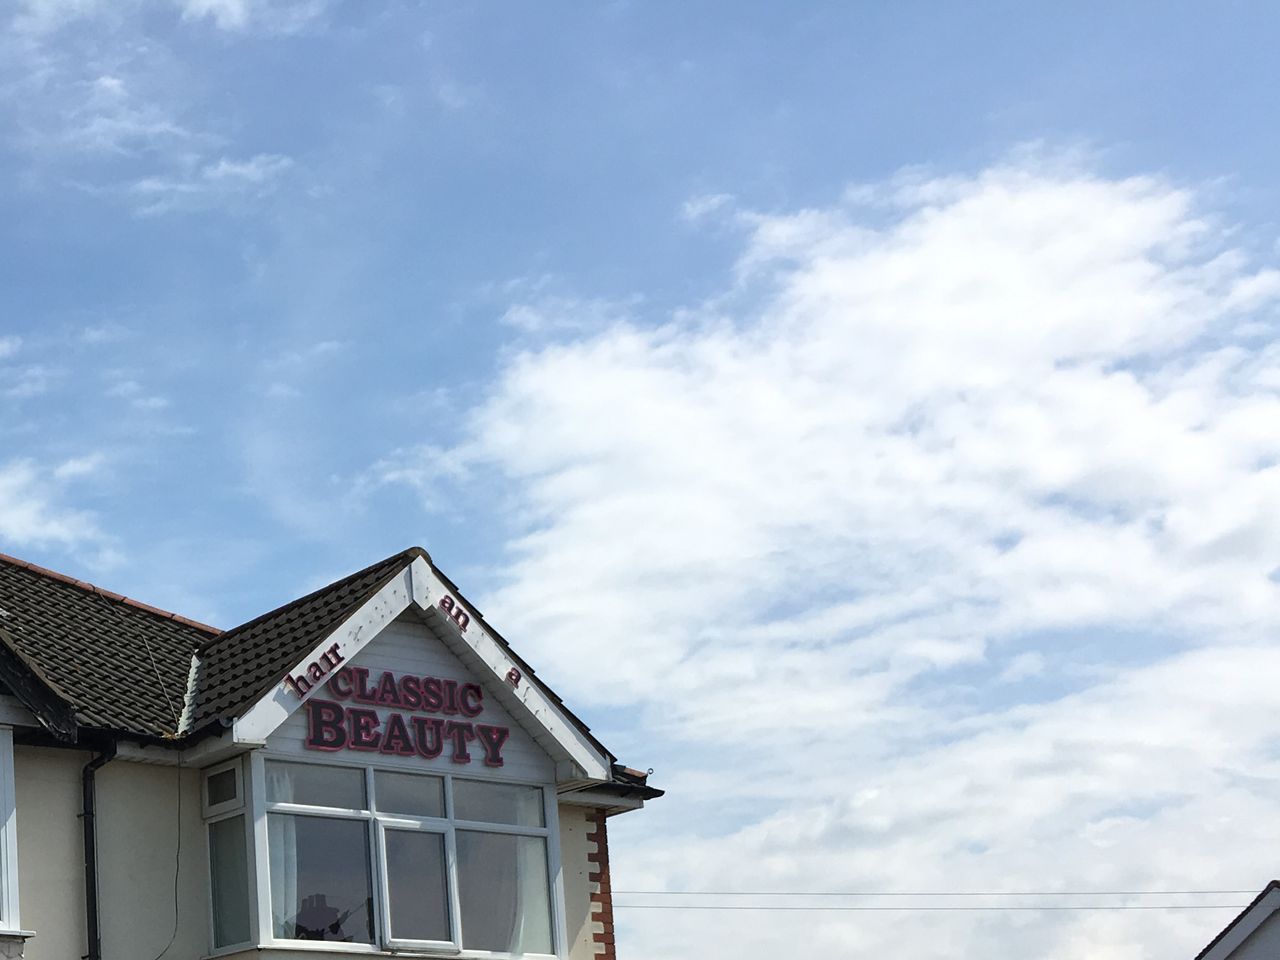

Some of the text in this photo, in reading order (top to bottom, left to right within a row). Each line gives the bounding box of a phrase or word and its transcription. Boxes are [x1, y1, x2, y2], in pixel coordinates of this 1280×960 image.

[283, 642, 345, 699] hair
[439, 594, 521, 689] an a
[327, 666, 484, 718] CLASSIC
[305, 698, 510, 768] BEAUTY
